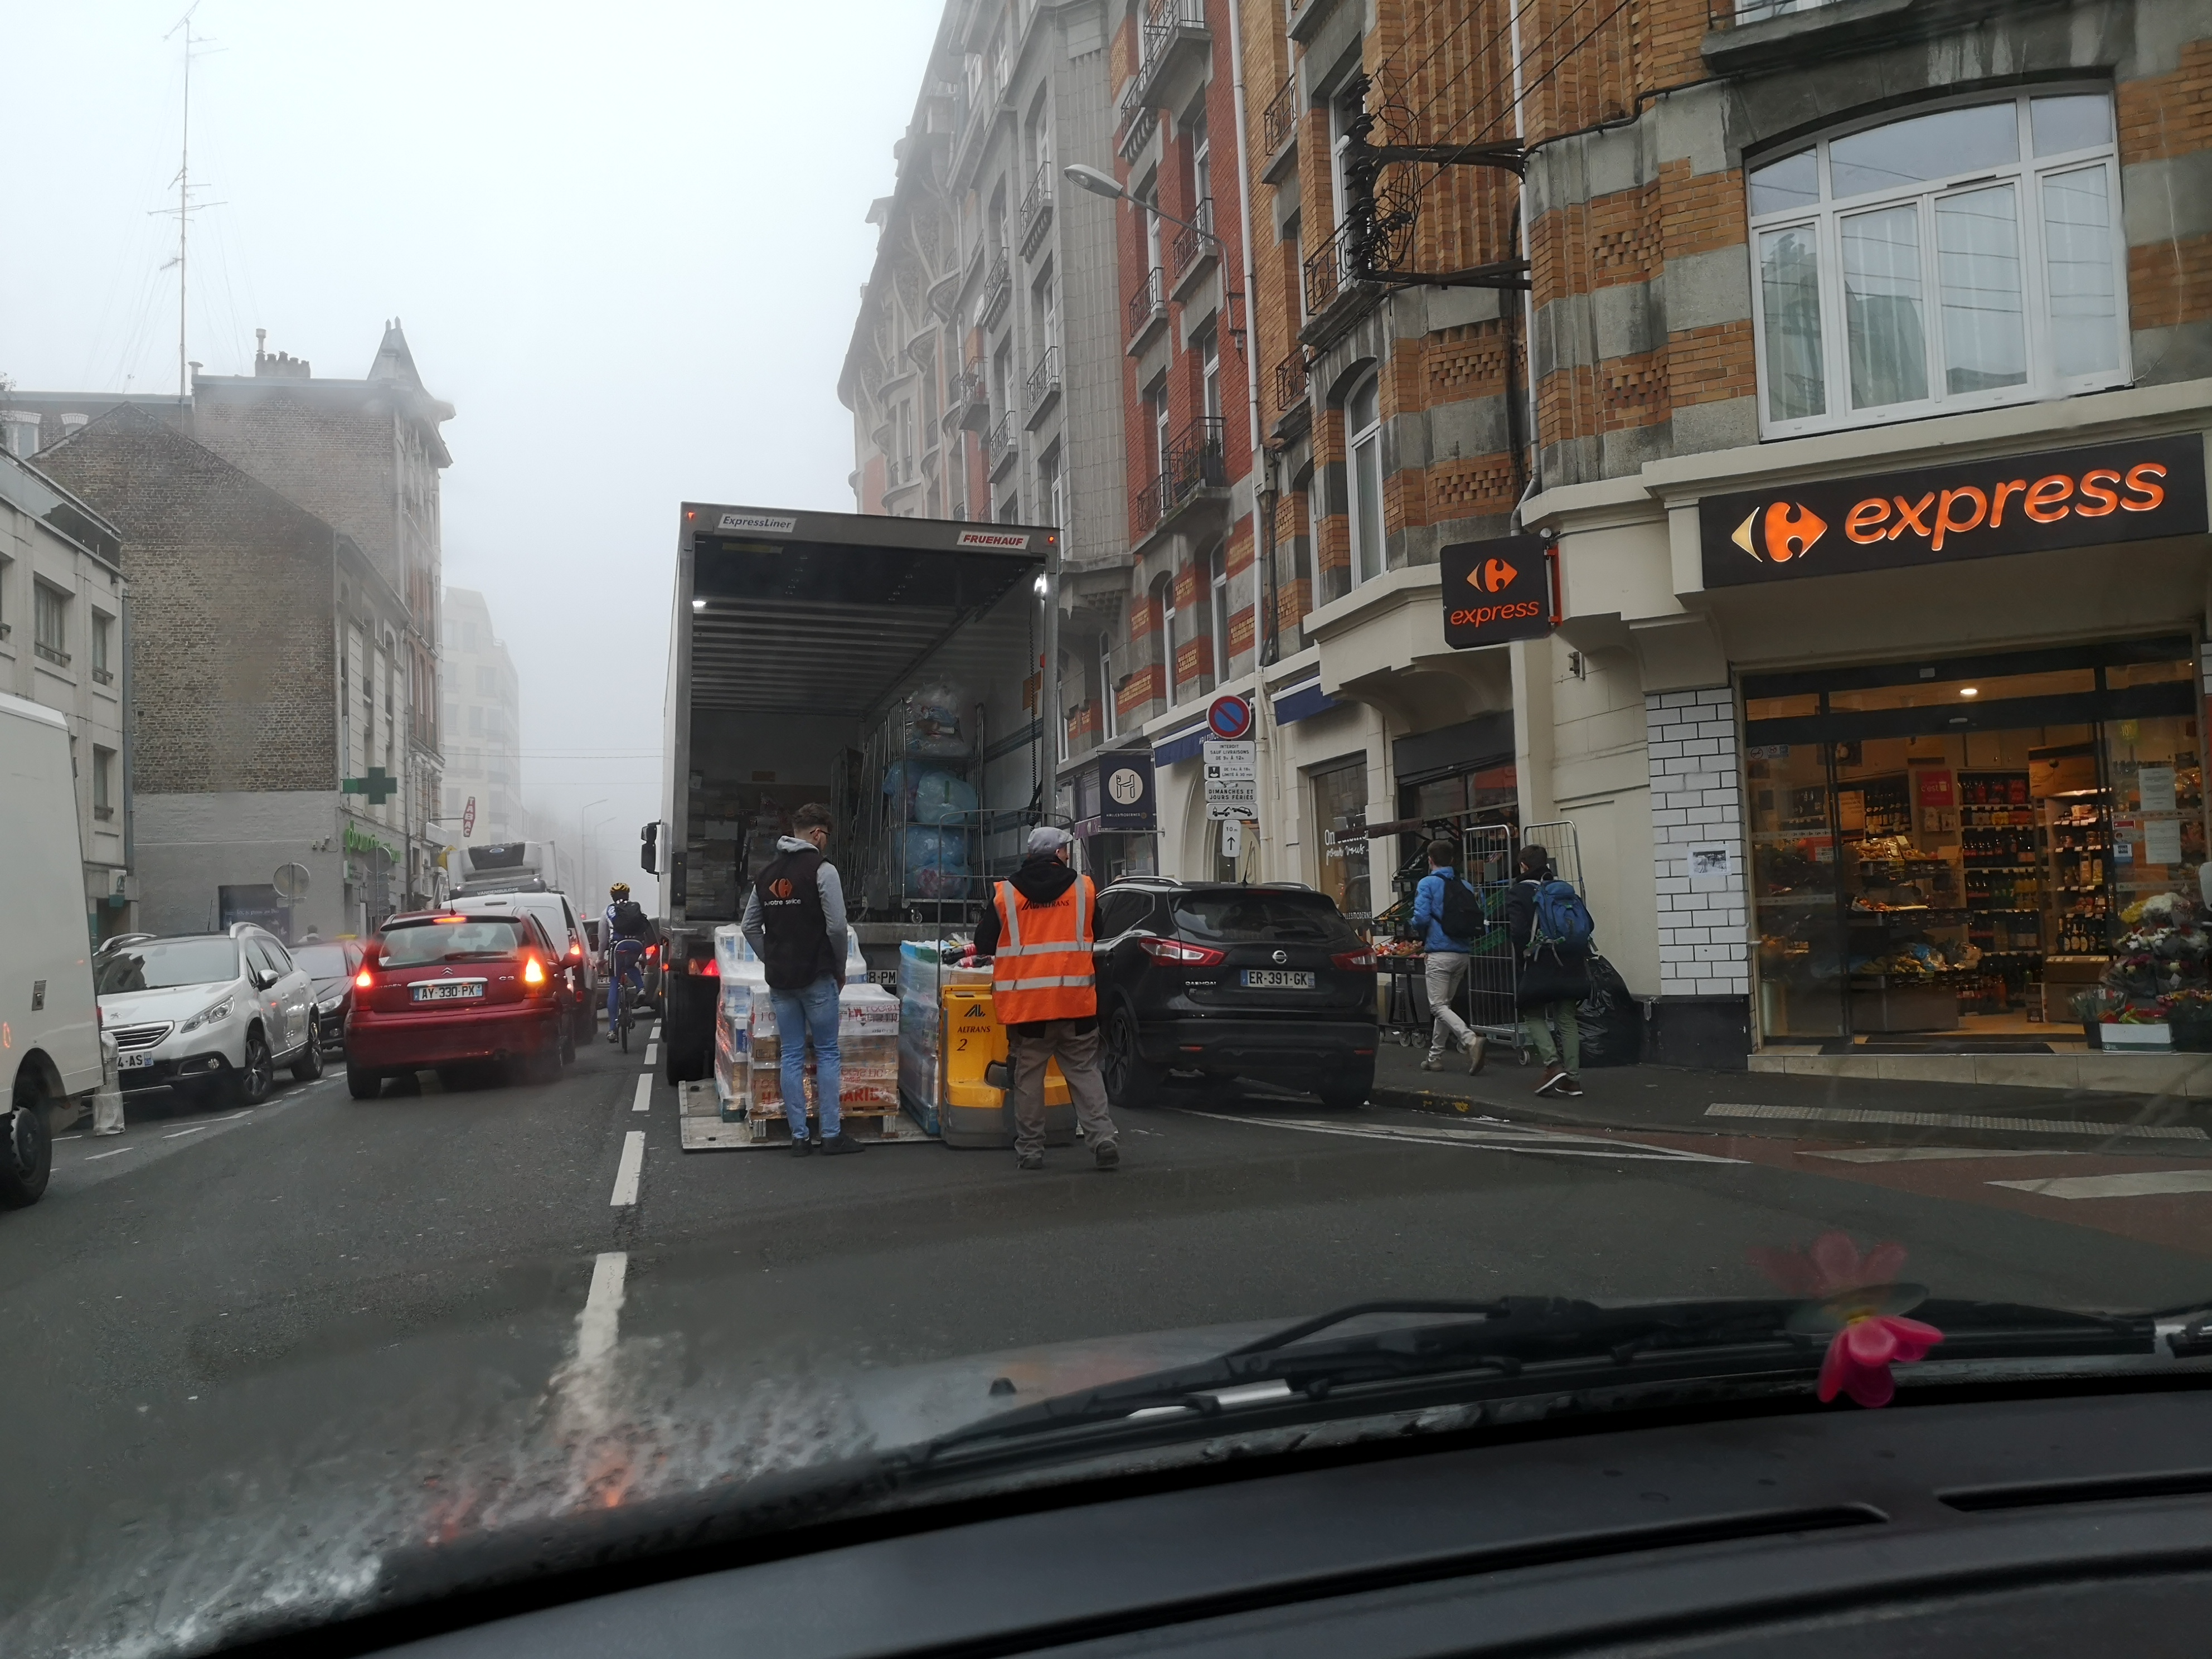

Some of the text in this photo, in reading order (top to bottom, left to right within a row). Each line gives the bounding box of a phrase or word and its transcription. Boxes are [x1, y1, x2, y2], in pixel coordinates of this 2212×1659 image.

[1845, 462, 2167, 551] express
[723, 516, 792, 528] ExpressLiner
[963, 534, 1023, 546] FRUEHAUF
[1451, 601, 1539, 627] express
[464, 797, 474, 836] TABAC
[1325, 829, 1336, 846] On
[477, 887, 519, 896] VANDENBULCKE
[866, 971, 896, 983] 8-PM
[1249, 972, 1307, 986] ER-391-GK
[422, 985, 474, 999] AY-330-PX
[957, 1038, 968, 1051] 2
